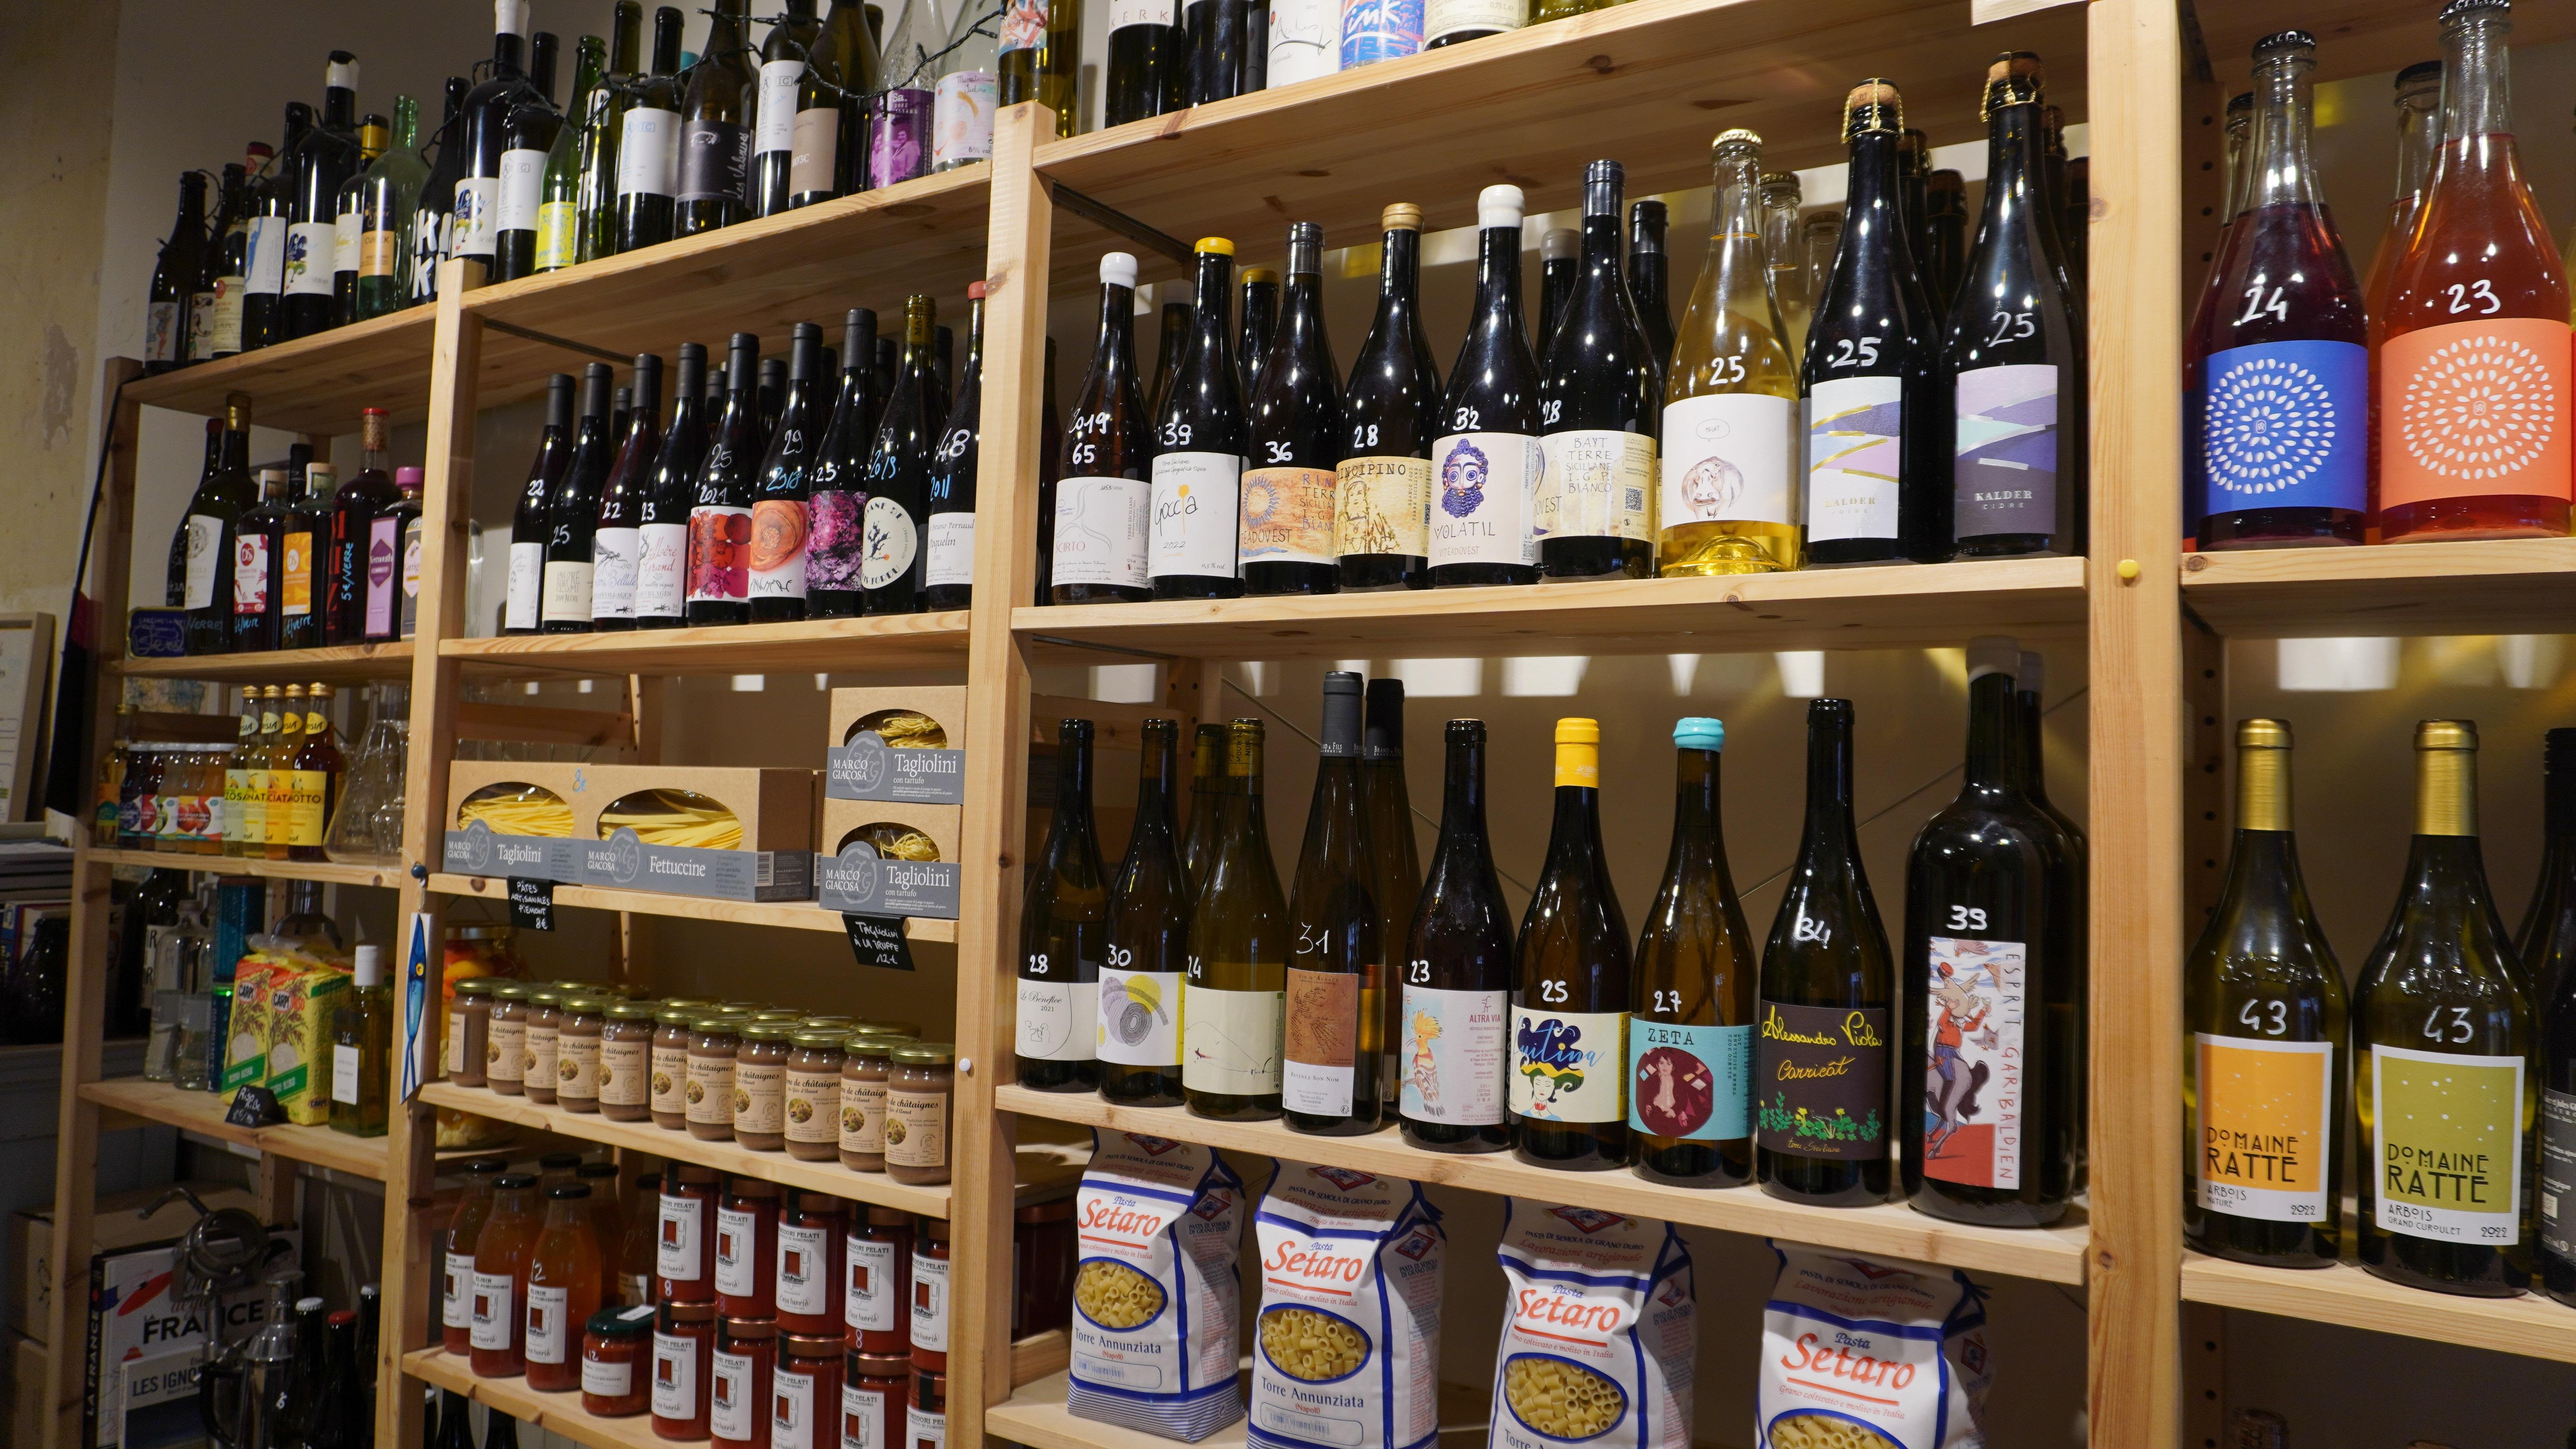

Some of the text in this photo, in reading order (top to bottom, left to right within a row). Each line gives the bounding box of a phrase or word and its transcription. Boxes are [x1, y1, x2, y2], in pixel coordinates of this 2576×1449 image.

[2239, 286, 2287, 321] 24
[2447, 279, 2501, 314] 23
[1985, 312, 2035, 347] 25
[1831, 336, 1882, 369] 25
[1709, 355, 1746, 386] 25
[1069, 408, 1110, 434] 2019
[1453, 407, 1480, 430] 32
[783, 429, 803, 455] 29
[881, 427, 894, 445] 32
[937, 427, 970, 461] 48
[1163, 423, 1192, 446] 39
[1355, 424, 1378, 448] 28
[1574, 437, 1608, 448] BAYT
[710, 448, 732, 469] 25
[1072, 443, 1096, 464] 65
[1266, 441, 1293, 463] 36
[1568, 451, 1613, 460] TERRE
[817, 466, 837, 482] 25
[1566, 463, 1613, 471] SICILIANE
[527, 479, 544, 496] 22
[766, 467, 802, 491] 2018
[1569, 483, 1611, 494] BIANCO
[699, 485, 731, 505] 2021
[1825, 497, 1876, 507] KALDER
[1974, 489, 2033, 502] KALDER
[602, 501, 622, 519] 22
[1983, 502, 2025, 510] CIDRE
[948, 518, 975, 529] Perraud
[1434, 522, 1495, 540] VOLATIL
[551, 524, 571, 546] 25
[1056, 540, 1085, 553] SCIRTO
[1440, 546, 1479, 557] VITEADOVEST
[833, 759, 868, 770] MARCO
[894, 753, 957, 777] Tagliolini
[832, 770, 867, 780] GIACOSA
[447, 850, 470, 859] GIACOSA
[448, 841, 471, 850] MARCO
[497, 844, 541, 865] Tagliolini
[587, 861, 615, 871] GIACOSA
[588, 851, 616, 861] MARCO
[649, 855, 706, 877] Fettuccine
[826, 869, 860, 881] MARCO
[886, 866, 950, 890] Tagliolini
[825, 881, 859, 891] GIACOSA
[896, 889, 917, 897] tartufo
[535, 918, 548, 930] 8€
[1296, 921, 1328, 954] 31
[1030, 955, 1048, 973] 28
[1108, 944, 1131, 967] 30
[1187, 955, 1201, 979] 24
[1411, 960, 1431, 983] 23
[1542, 979, 1568, 1003] 25
[1654, 990, 1682, 1013] 27
[1470, 1014, 1501, 1023] ALTRA VIA
[1762, 1005, 1883, 1047] Alessandro Viola
[2240, 999, 2287, 1035] 43
[2424, 1006, 2475, 1043] 43
[1648, 1028, 1695, 1045] ZETA
[696, 1063, 733, 1074] châtaignes
[742, 1071, 779, 1082] châtaignes
[1998, 953, 2021, 1180] ESPRIT GARIBALDIEN
[897, 1099, 939, 1111] châtaignes
[2206, 1126, 2300, 1155] DOMAINE
[2206, 1147, 2299, 1183] RATTE
[2388, 1143, 2490, 1174] DOMAINE
[2207, 1185, 2247, 1201] ARBOIS
[2388, 1165, 2489, 1203] RATTE
[1112, 1196, 1136, 1207] Pasta
[1281, 1194, 1340, 1216] Lavorazione
[1317, 1192, 1342, 1203] SEMOLA
[1078, 1199, 1161, 1237] Setaro
[2290, 1203, 2316, 1216] 2022
[2388, 1204, 2433, 1222] ARBOIS
[2388, 1216, 2461, 1236] GRAND CUROULET
[2481, 1226, 2507, 1238] 2022
[1137, 1252, 1153, 1260] Italia
[1309, 1242, 1333, 1251] Pasta
[530, 1258, 546, 1282] 12
[1264, 1240, 1363, 1282] Setaro
[664, 1279, 673, 1297] 8
[1263, 1284, 1357, 1307] Grano coltivato molito Italia
[1553, 1284, 1584, 1299] Pasta
[1516, 1289, 1621, 1332] Setaro
[1075, 1327, 1161, 1354] Torre Annunziata
[1834, 1332, 1871, 1349] Pasta
[1780, 1333, 1916, 1390] Setaro
[1261, 1376, 1286, 1397] Torre
[1291, 1388, 1364, 1408] Annunziata
[1779, 1385, 1905, 1419] Grano coltivato molito Italia
